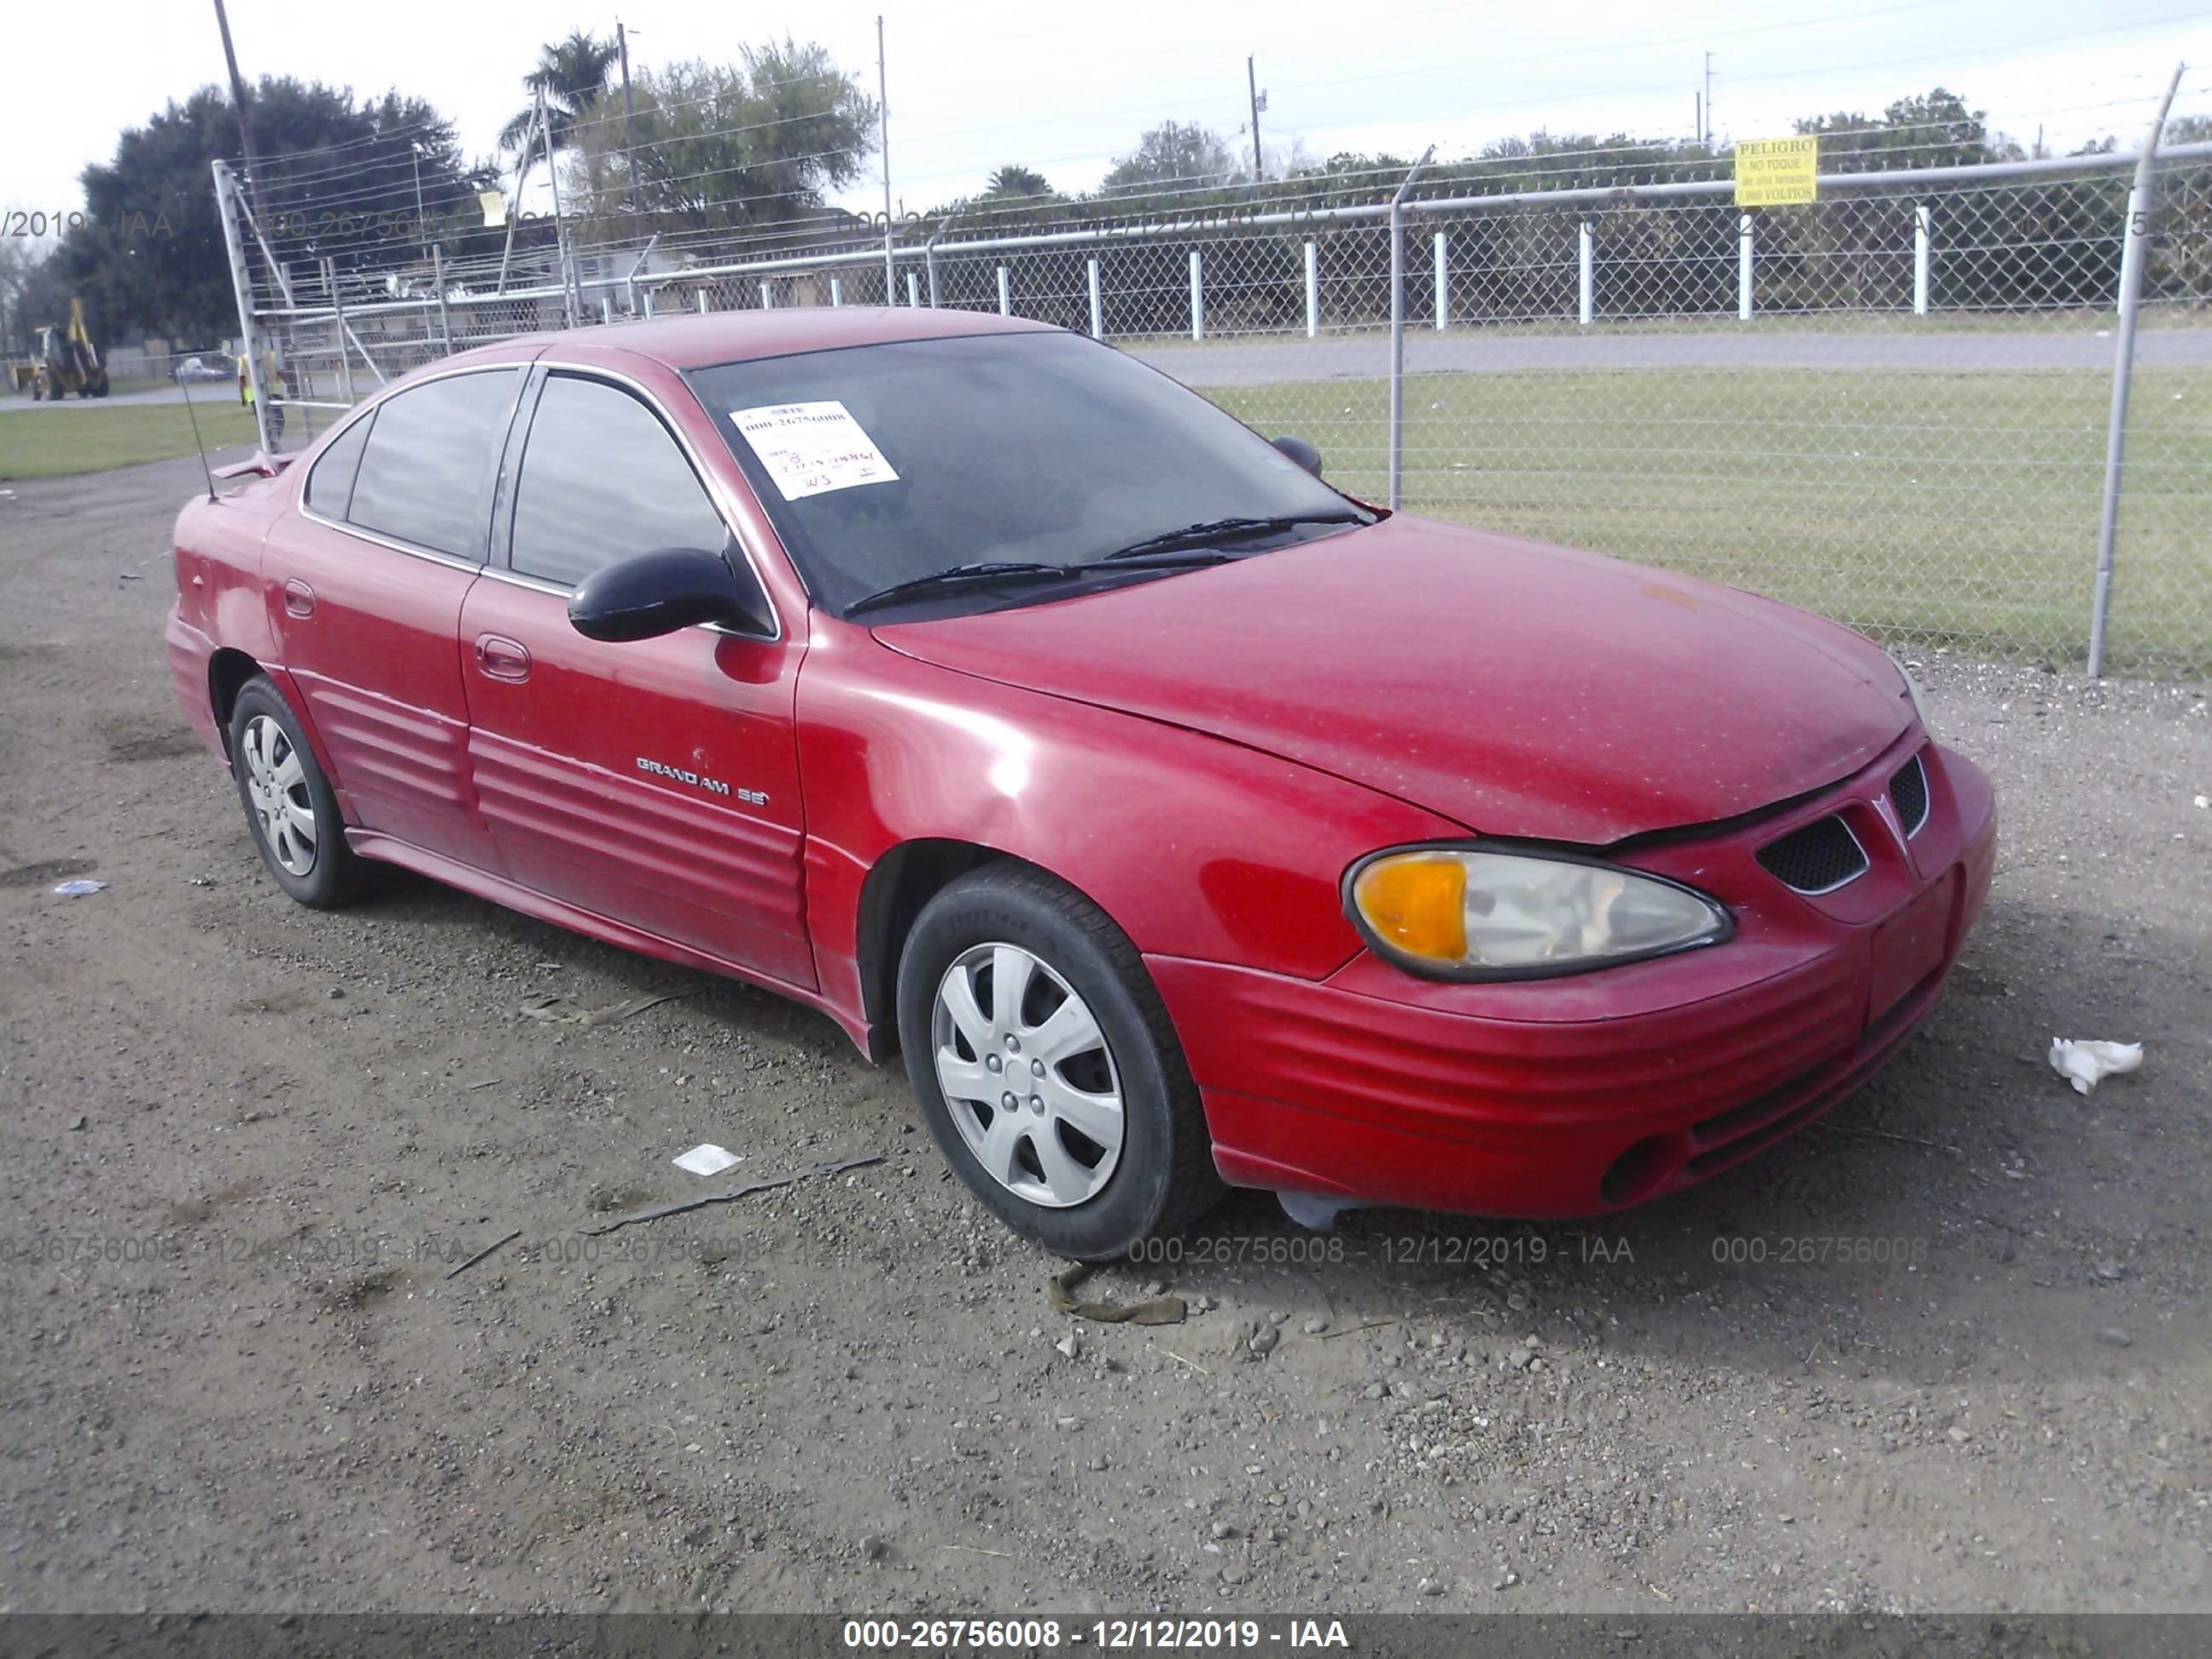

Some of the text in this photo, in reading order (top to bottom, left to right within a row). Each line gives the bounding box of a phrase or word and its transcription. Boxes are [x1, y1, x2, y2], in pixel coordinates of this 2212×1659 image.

[1741, 139, 1813, 154] PELIGRO
[1749, 158, 1802, 171] NO TOQUE
[1765, 187, 1812, 200] VOLTIOS
[745, 414, 846, 431] 000-26756008
[636, 757, 768, 806] GRAND AM SE
